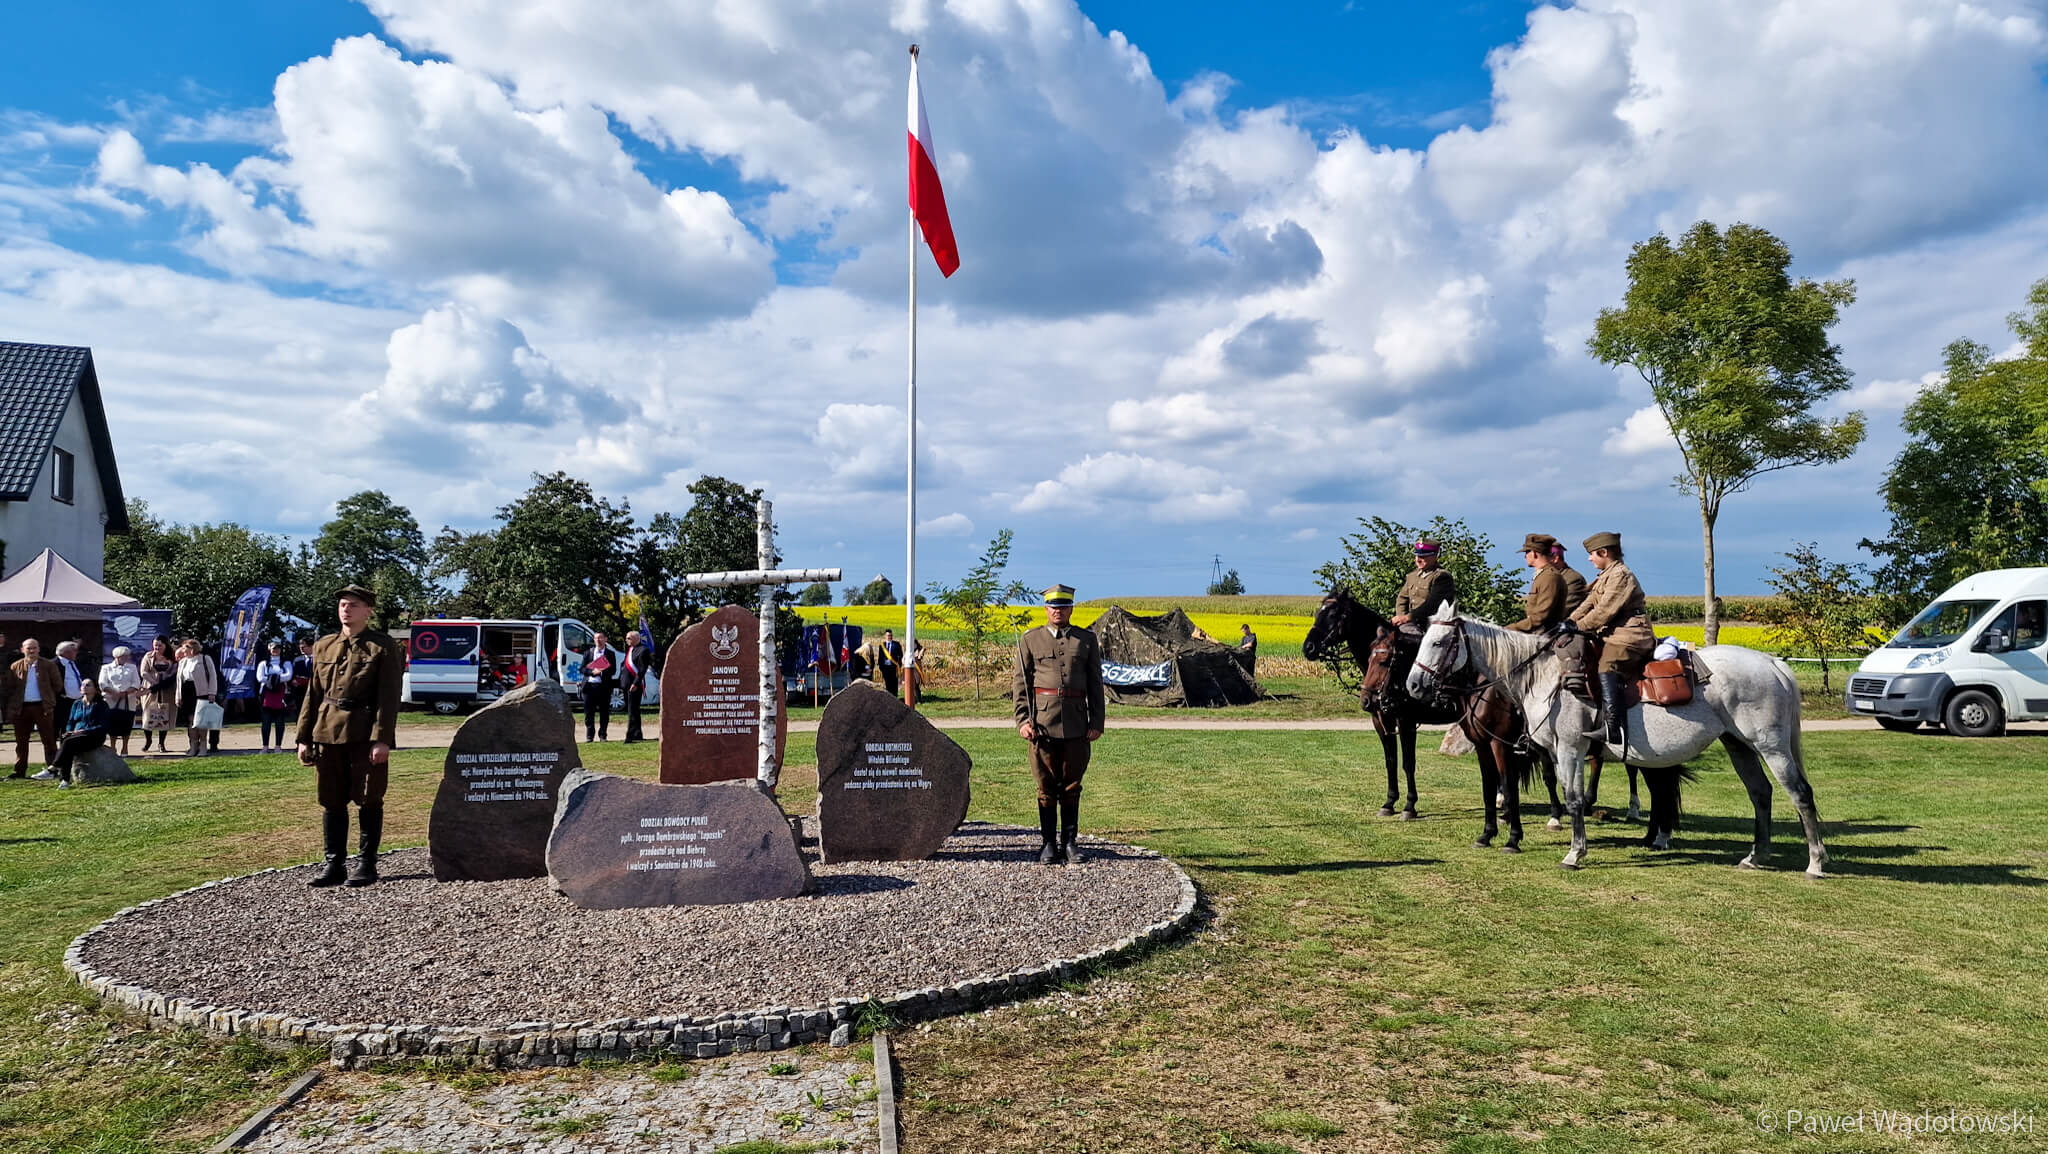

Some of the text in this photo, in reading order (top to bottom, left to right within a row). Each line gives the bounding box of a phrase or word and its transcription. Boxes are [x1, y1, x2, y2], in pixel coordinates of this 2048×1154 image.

[712, 666, 738, 674] JANOWO
[865, 743, 912, 752] ODDZIAŁ ROTMISTRZA
[456, 752, 558, 763] ODDZIAŁ WYDZIELONY WOJSKA POLSKIEGO
[472, 766, 493, 777] Henryka
[494, 766, 529, 776] Dobrzańskiego
[854, 768, 867, 776] dostał
[882, 768, 898, 776] niewoli
[899, 767, 922, 777] niemieckiej
[470, 779, 495, 790] przedostał
[496, 779, 504, 790] się
[844, 780, 861, 790] podczas
[862, 779, 875, 790] próby
[875, 779, 903, 790] przedostania
[468, 792, 485, 803] walczył
[490, 791, 514, 800] Niemcami
[515, 792, 522, 800] do
[523, 791, 535, 800] 1940
[640, 814, 708, 828] ODDZIAŁ DOWÓDCY PUŁKU
[636, 832, 655, 843] Jerzego
[639, 845, 706, 858] przedostał się nad Biebrzę
[630, 861, 649, 872] walczył
[654, 860, 680, 869] Sowietami
[681, 859, 688, 869] do
[689, 858, 703, 868] 1940
